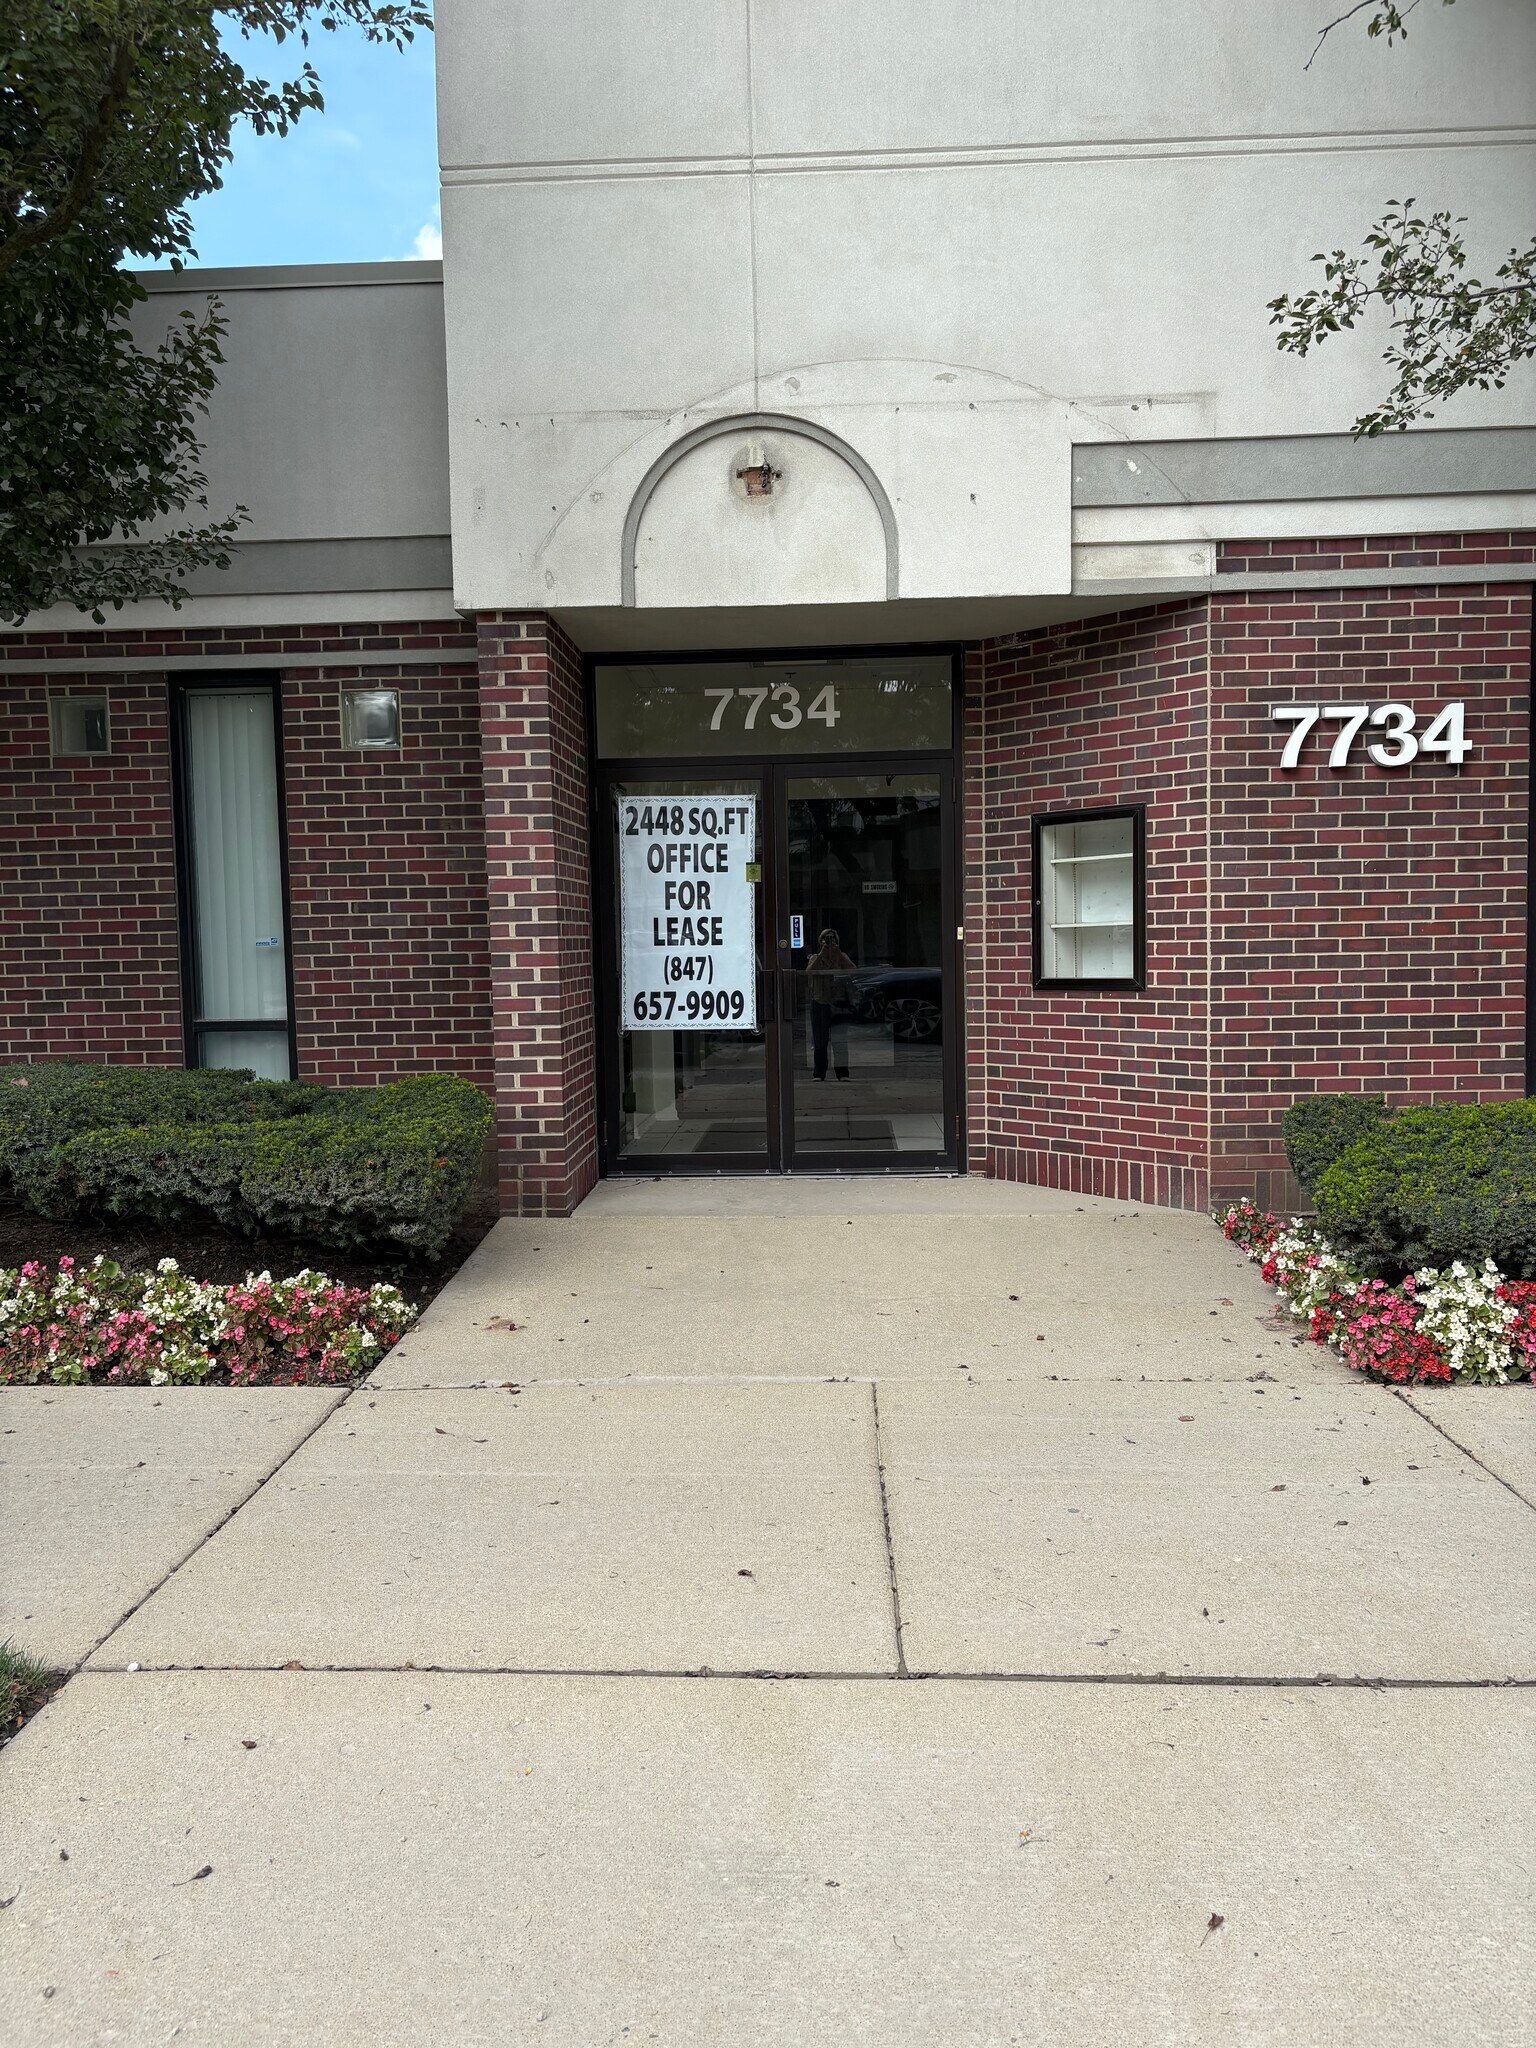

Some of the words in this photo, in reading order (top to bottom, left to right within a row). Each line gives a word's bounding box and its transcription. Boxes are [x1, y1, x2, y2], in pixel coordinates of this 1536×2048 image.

[704, 685, 841, 730] 7734
[1272, 702, 1473, 768] 7734
[625, 805, 684, 836] 2448
[688, 807, 749, 839] SQ.FT
[647, 843, 729, 873] OFFICE
[664, 880, 711, 910] FOR
[653, 916, 723, 946] LEASE
[664, 955, 714, 985] (847)
[633, 990, 745, 1021] 657-9909
